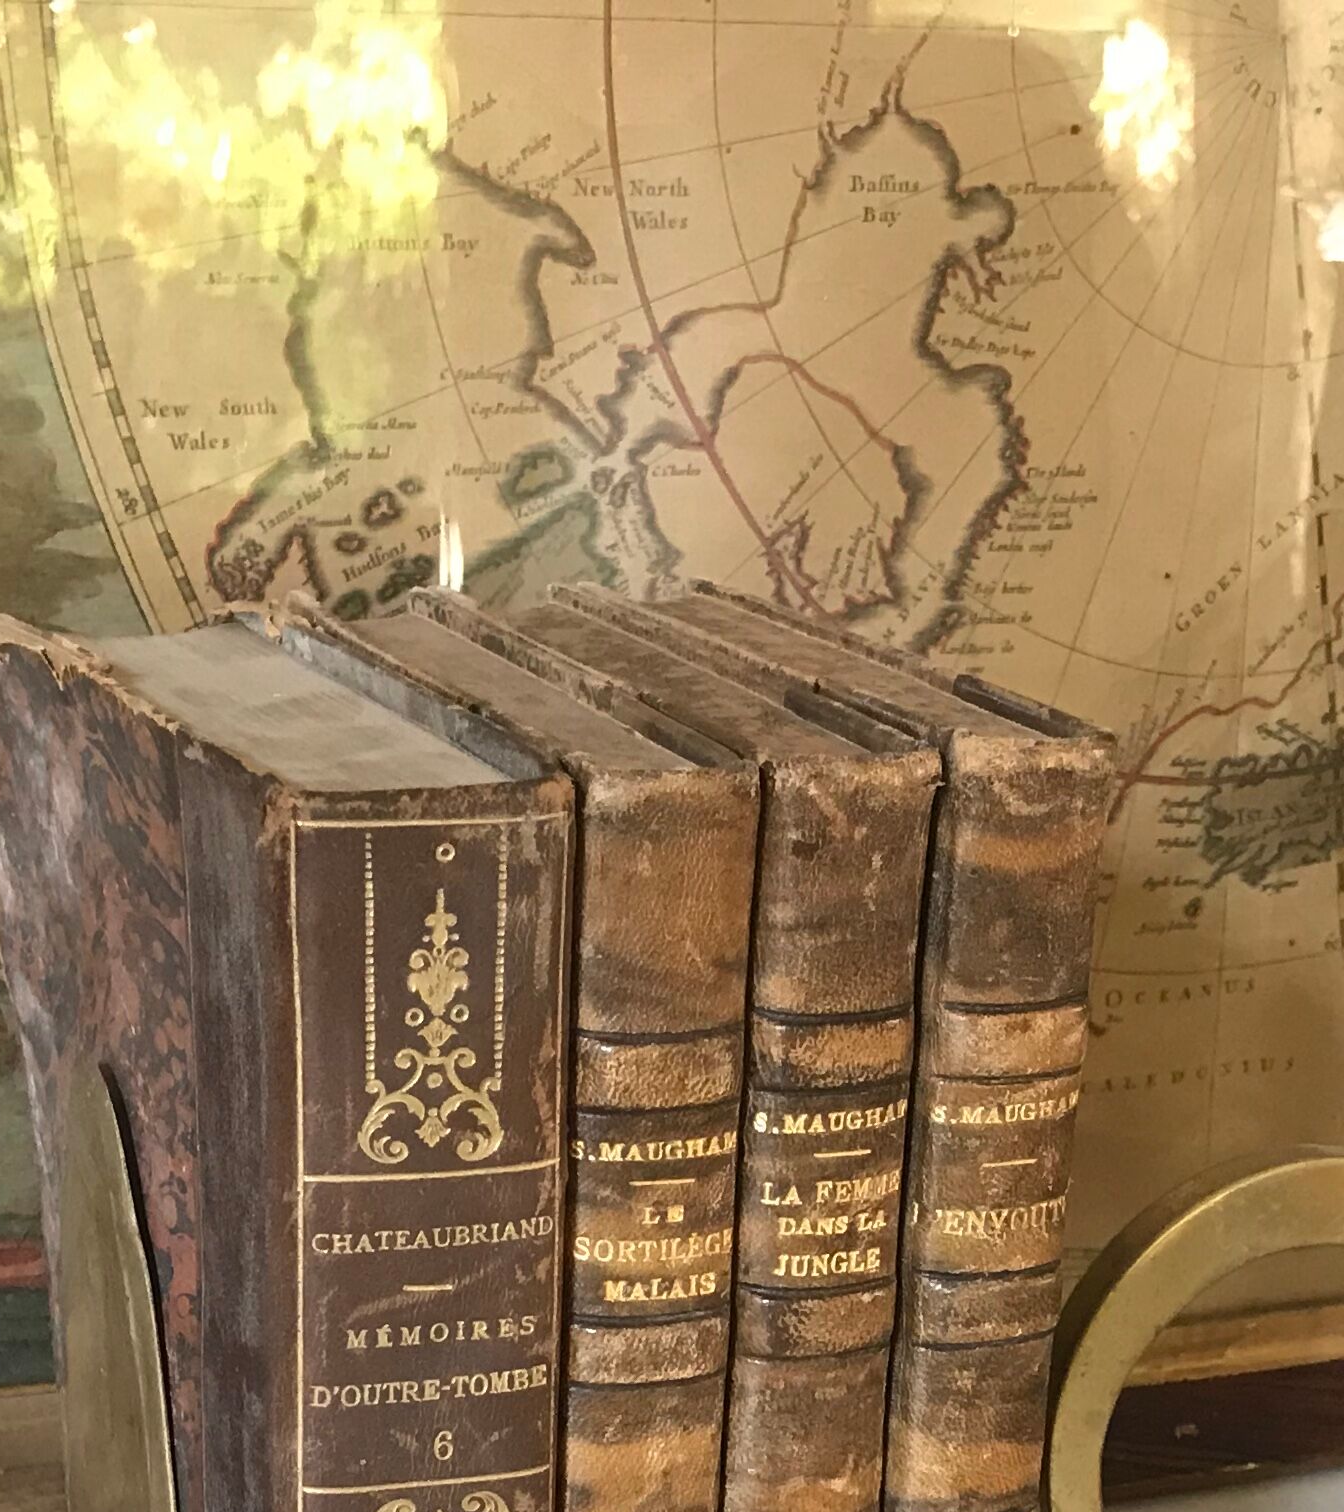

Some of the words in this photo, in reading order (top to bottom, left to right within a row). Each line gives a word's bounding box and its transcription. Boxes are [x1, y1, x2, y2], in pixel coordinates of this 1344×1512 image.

[628, 175, 690, 198] North
[629, 210, 689, 230] Wales
[860, 206, 901, 227] Bay
[139, 397, 190, 419] New
[218, 397, 278, 417] South
[166, 430, 231, 451] Wales
[760, 1182, 803, 1206] LA
[815, 1168, 901, 1204] FEMME
[641, 1204, 685, 1226] LE
[776, 1215, 850, 1237] DANS
[857, 1210, 887, 1232] LA
[311, 1214, 553, 1255] CHATEAUBRIAND
[771, 1247, 881, 1278] JUNGLE
[604, 1271, 717, 1303] MALAIS
[346, 1314, 539, 1350] MÉMOIRES
[309, 1363, 547, 1408] D'OUTRE-TOMBE
[433, 1430, 454, 1461] 6
